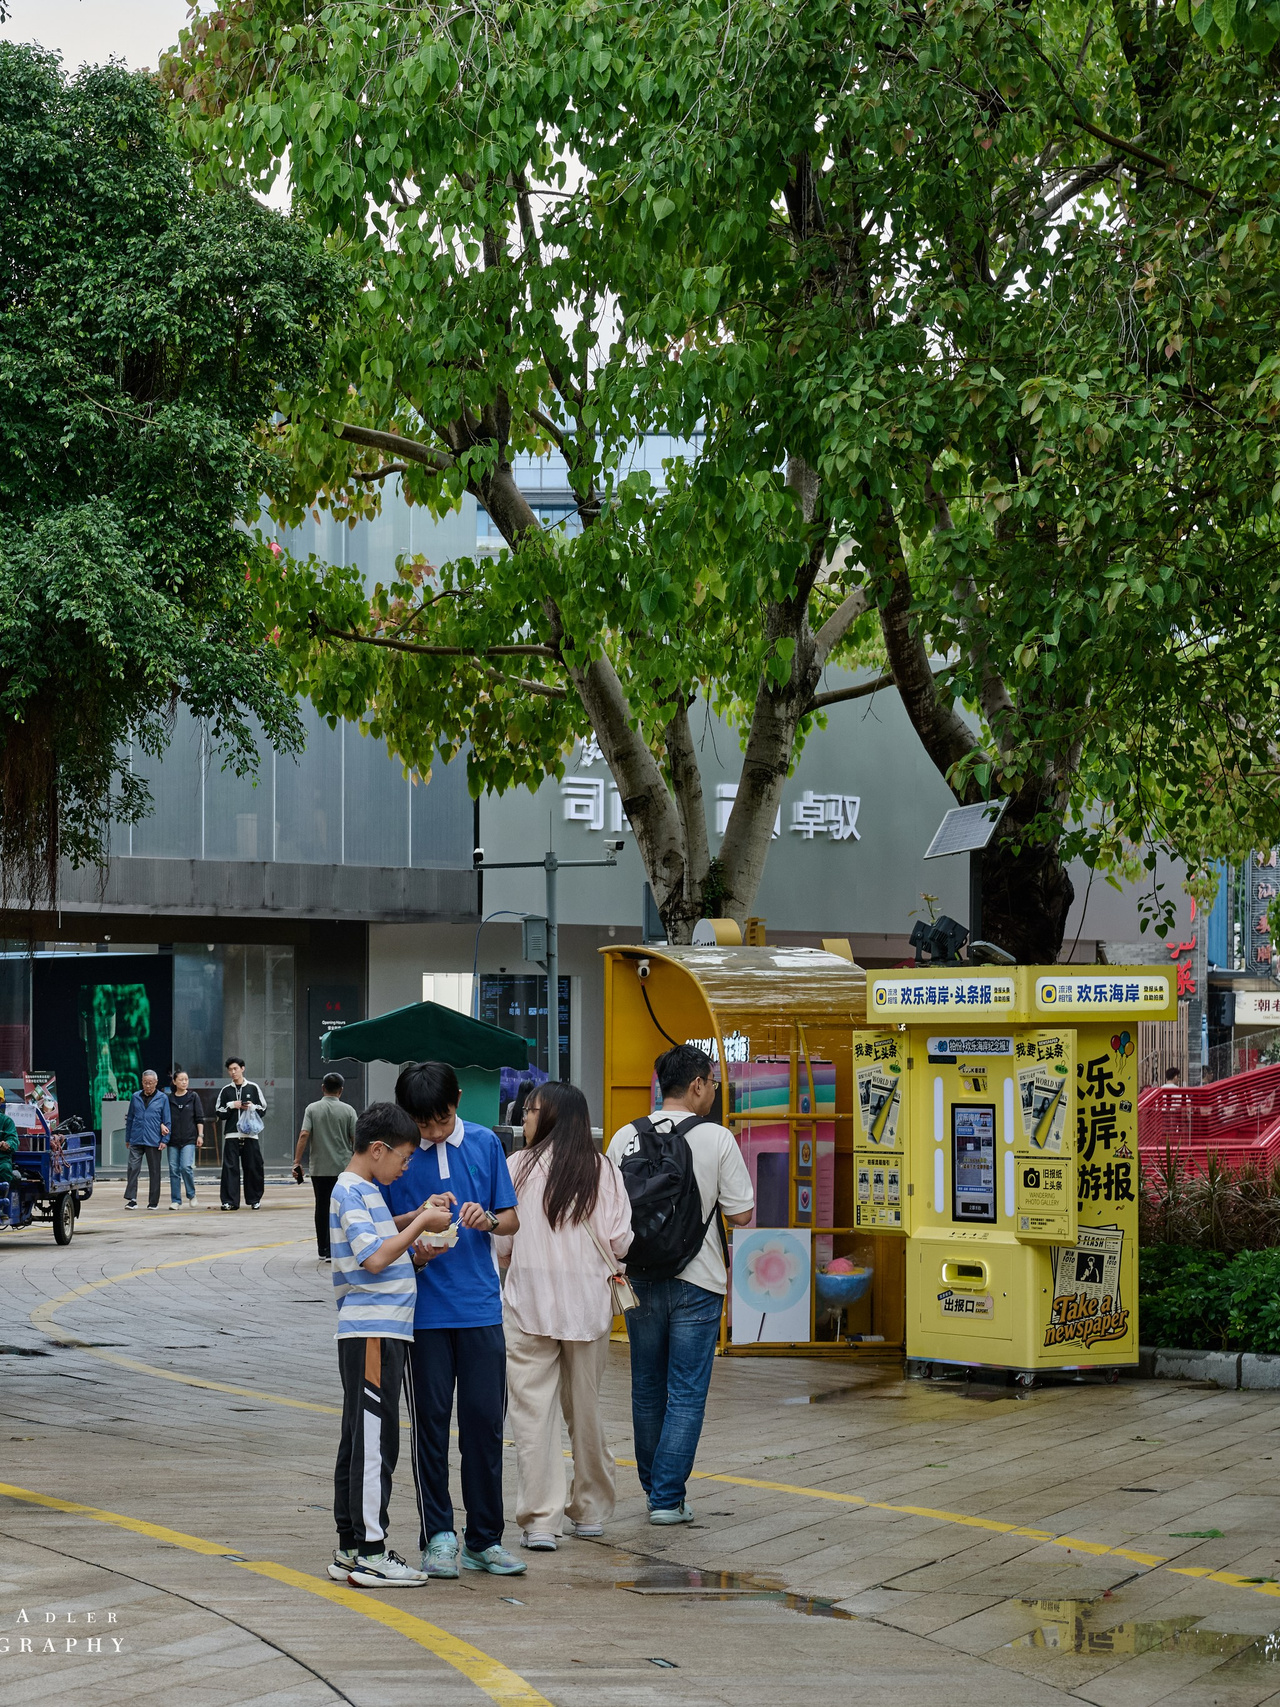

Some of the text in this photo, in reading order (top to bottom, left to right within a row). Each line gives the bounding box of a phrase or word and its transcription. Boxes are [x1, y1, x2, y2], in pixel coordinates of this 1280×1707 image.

[561, 776, 862, 841] 司 卓驭
[900, 985, 992, 1005] 欢乐海岸·头条报
[1077, 984, 1139, 1003] 欢乐海岸
[1035, 1077, 1054, 1087] WORLD
[1042, 1169, 1063, 1179] 旧报纸
[1042, 1180, 1063, 1190] 上头条
[1083, 1235, 1104, 1248] FLASH
[944, 1298, 975, 1313] 出报口
[1053, 1291, 1113, 1323] Take a
[1043, 1309, 1129, 1349] newspaper
